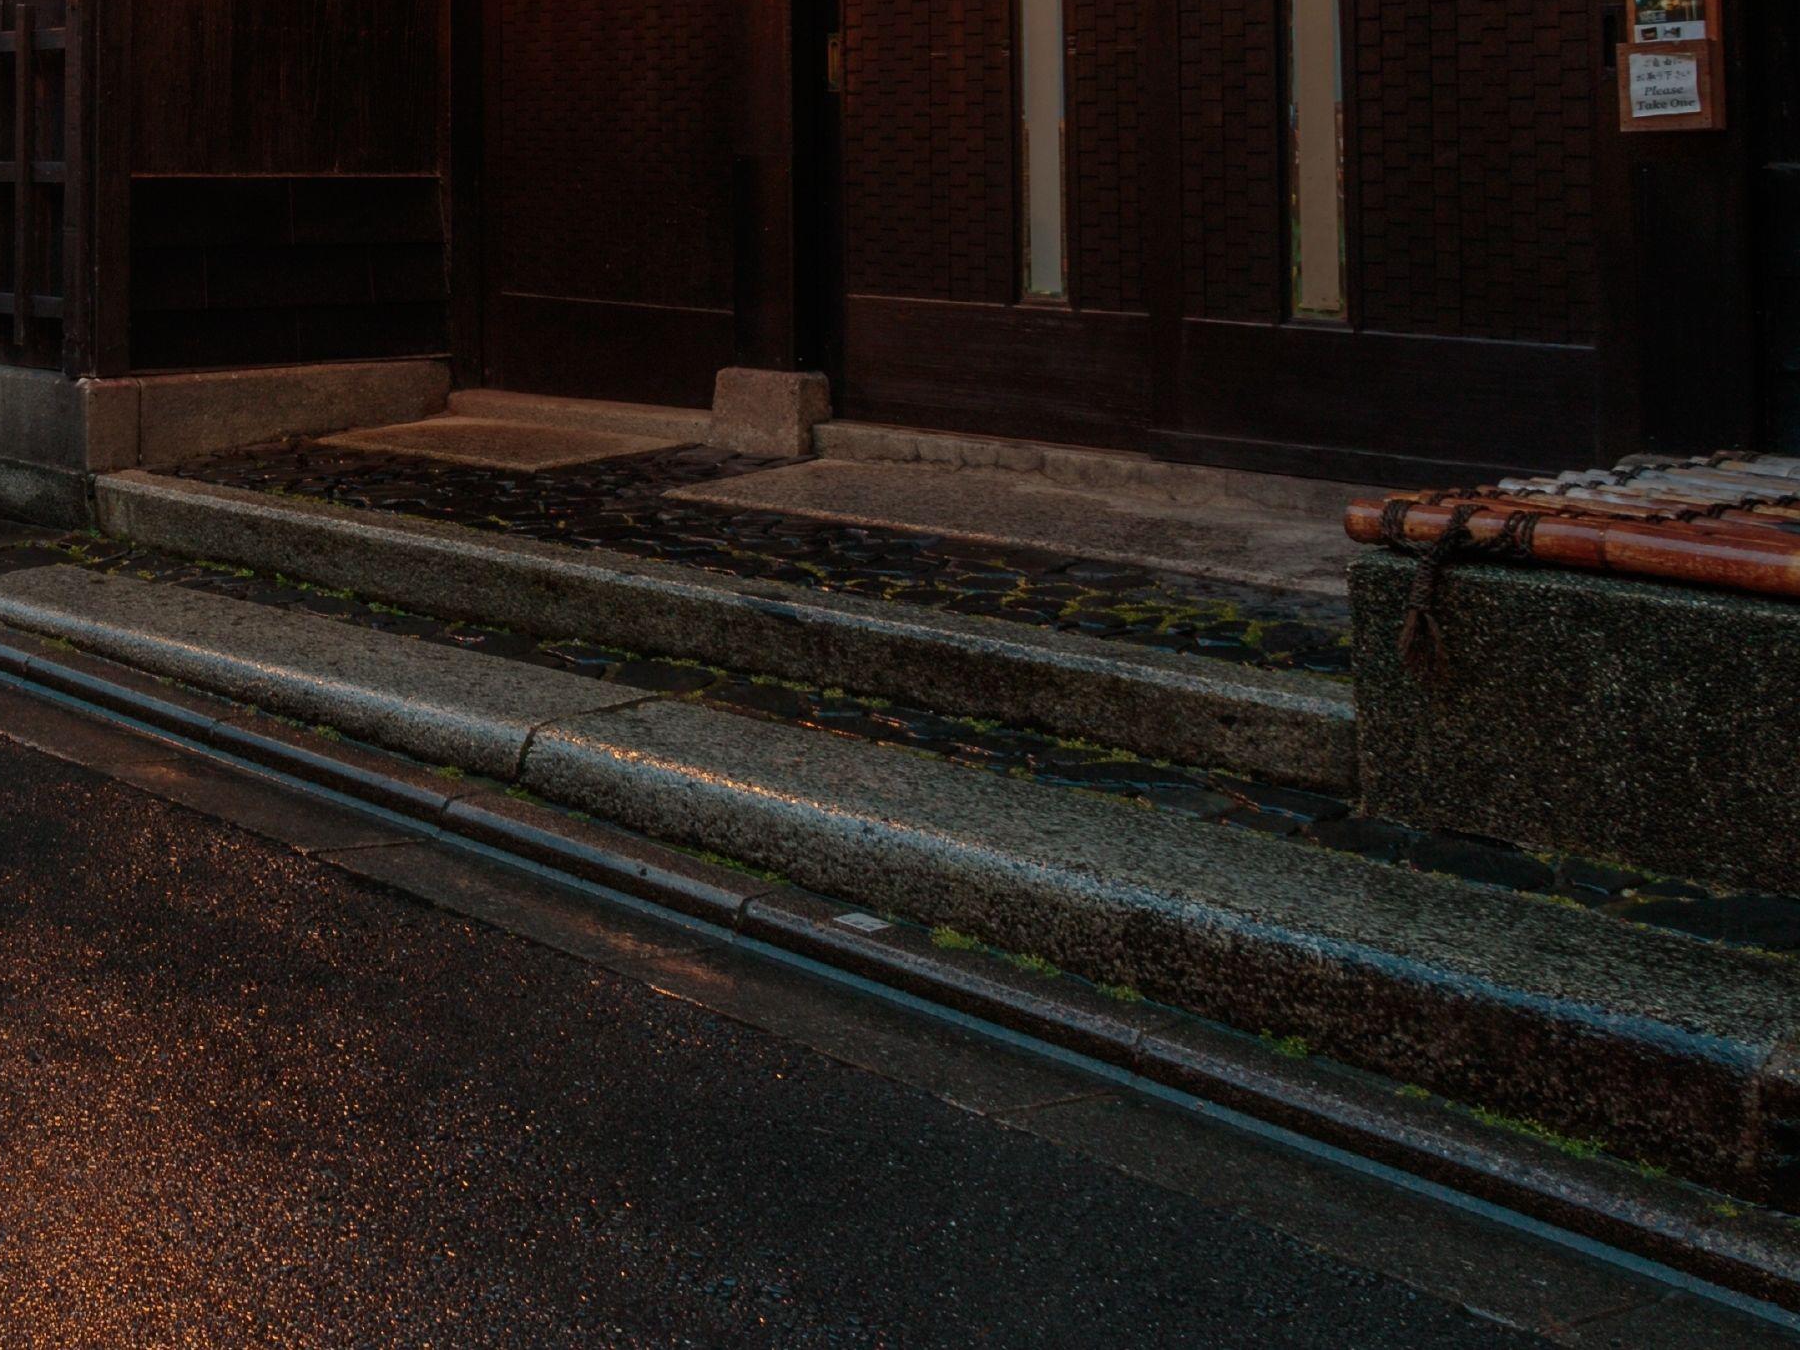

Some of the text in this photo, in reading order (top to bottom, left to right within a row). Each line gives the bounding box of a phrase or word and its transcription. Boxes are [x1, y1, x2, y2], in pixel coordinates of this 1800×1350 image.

[1644, 86, 1684, 96] Please
[1636, 98, 1696, 111] Take One
